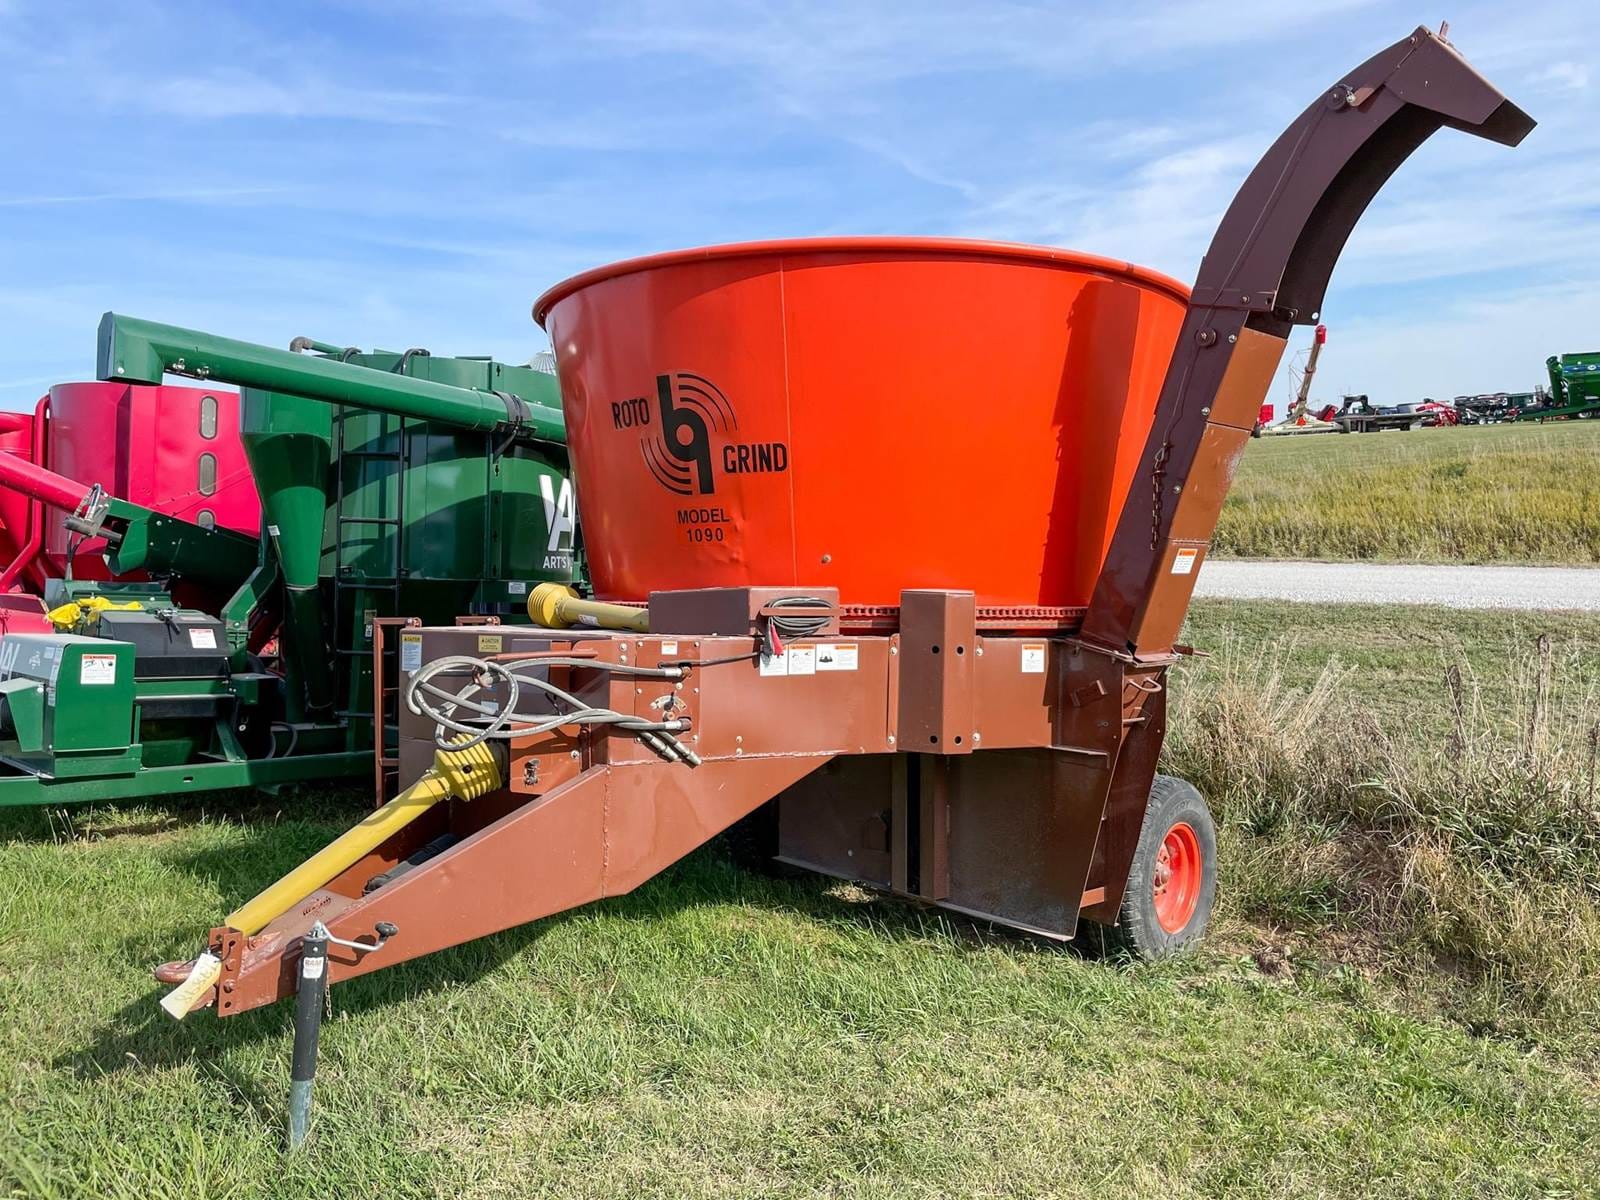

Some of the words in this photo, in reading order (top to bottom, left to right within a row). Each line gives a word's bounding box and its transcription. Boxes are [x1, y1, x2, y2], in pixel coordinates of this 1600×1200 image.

[611, 397, 651, 430] ROTO
[722, 442, 789, 475] GRIND
[677, 507, 731, 525] MODEL
[686, 527, 725, 543] 1090
